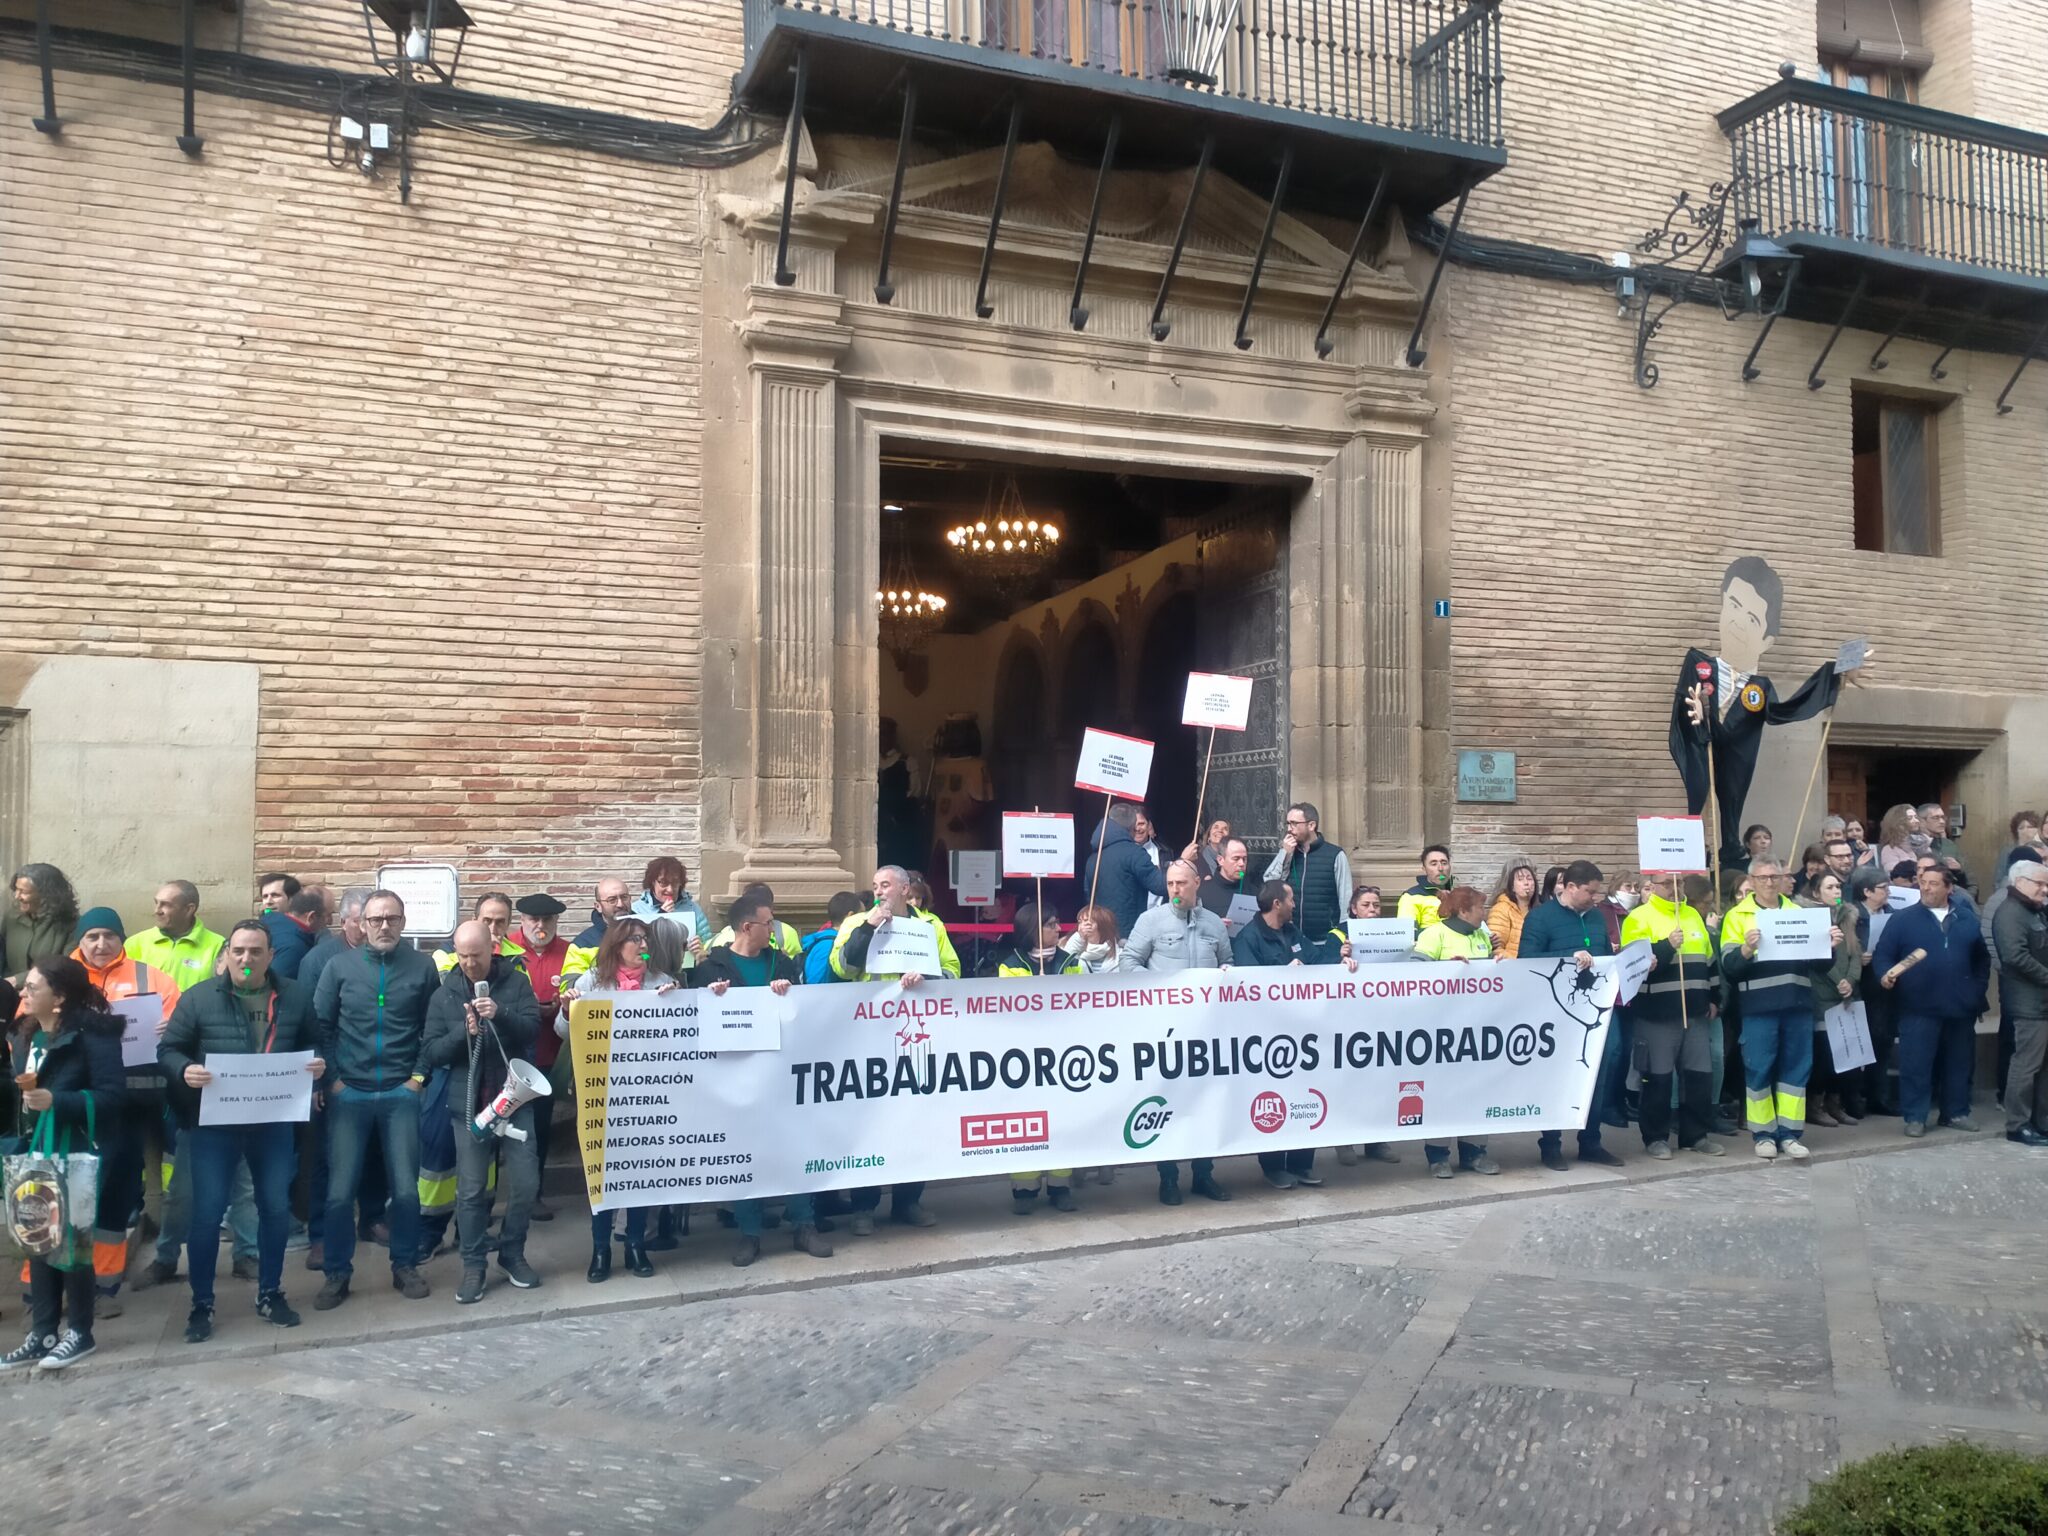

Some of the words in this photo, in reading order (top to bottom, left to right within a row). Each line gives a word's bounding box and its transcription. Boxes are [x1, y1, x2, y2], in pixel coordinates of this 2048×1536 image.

[1437, 600, 1446, 617] 1
[853, 999, 959, 1021] ALCALDE,
[966, 994, 1044, 1015] MENOS
[1050, 986, 1195, 1010] EXPEDIENTES
[1198, 986, 1215, 1004] Y
[1218, 980, 1262, 1003] MÁS
[1268, 981, 1357, 1001] CUMPLIR
[1362, 976, 1504, 999] COMPROMISOS
[588, 1009, 610, 1020] SIN
[587, 1030, 609, 1040] SIN
[613, 1029, 669, 1040] CARRERA
[585, 1053, 607, 1064] SIN
[791, 1042, 1119, 1106] TRABAJADOR@S
[1133, 1028, 1320, 1081] PÚBLIC@S
[1334, 1022, 1556, 1069] IGNORAD@S
[585, 1077, 606, 1088] SIN
[610, 1072, 693, 1086] VALORACIÓN
[585, 1097, 605, 1109] SIN
[608, 1095, 670, 1107] MATERIAL
[1254, 1097, 1282, 1114] UGT
[1289, 1101, 1319, 1110] Servicios
[1289, 1111, 1318, 1120] Públicos
[1400, 1114, 1422, 1125] CGT
[1485, 1104, 1541, 1119] #BastaYa
[585, 1118, 604, 1130] SIN
[608, 1115, 678, 1127] VESTUARIO
[1133, 1111, 1174, 1131] CSIF
[966, 1117, 1044, 1142] CCOO
[586, 1139, 602, 1151] SIN
[606, 1136, 665, 1148] MEJORAS
[668, 1132, 726, 1145] SOCIALES
[961, 1147, 994, 1157] servicios
[587, 1163, 601, 1175] SIN
[605, 1156, 676, 1172] PROVISIÓN
[680, 1157, 696, 1167] DE
[700, 1153, 752, 1166] PUESTOS
[804, 1153, 885, 1174] #Movilizate
[589, 1184, 601, 1197] SIN
[604, 1176, 702, 1193] INSTALACIONES
[705, 1173, 753, 1186] DIGNAS
